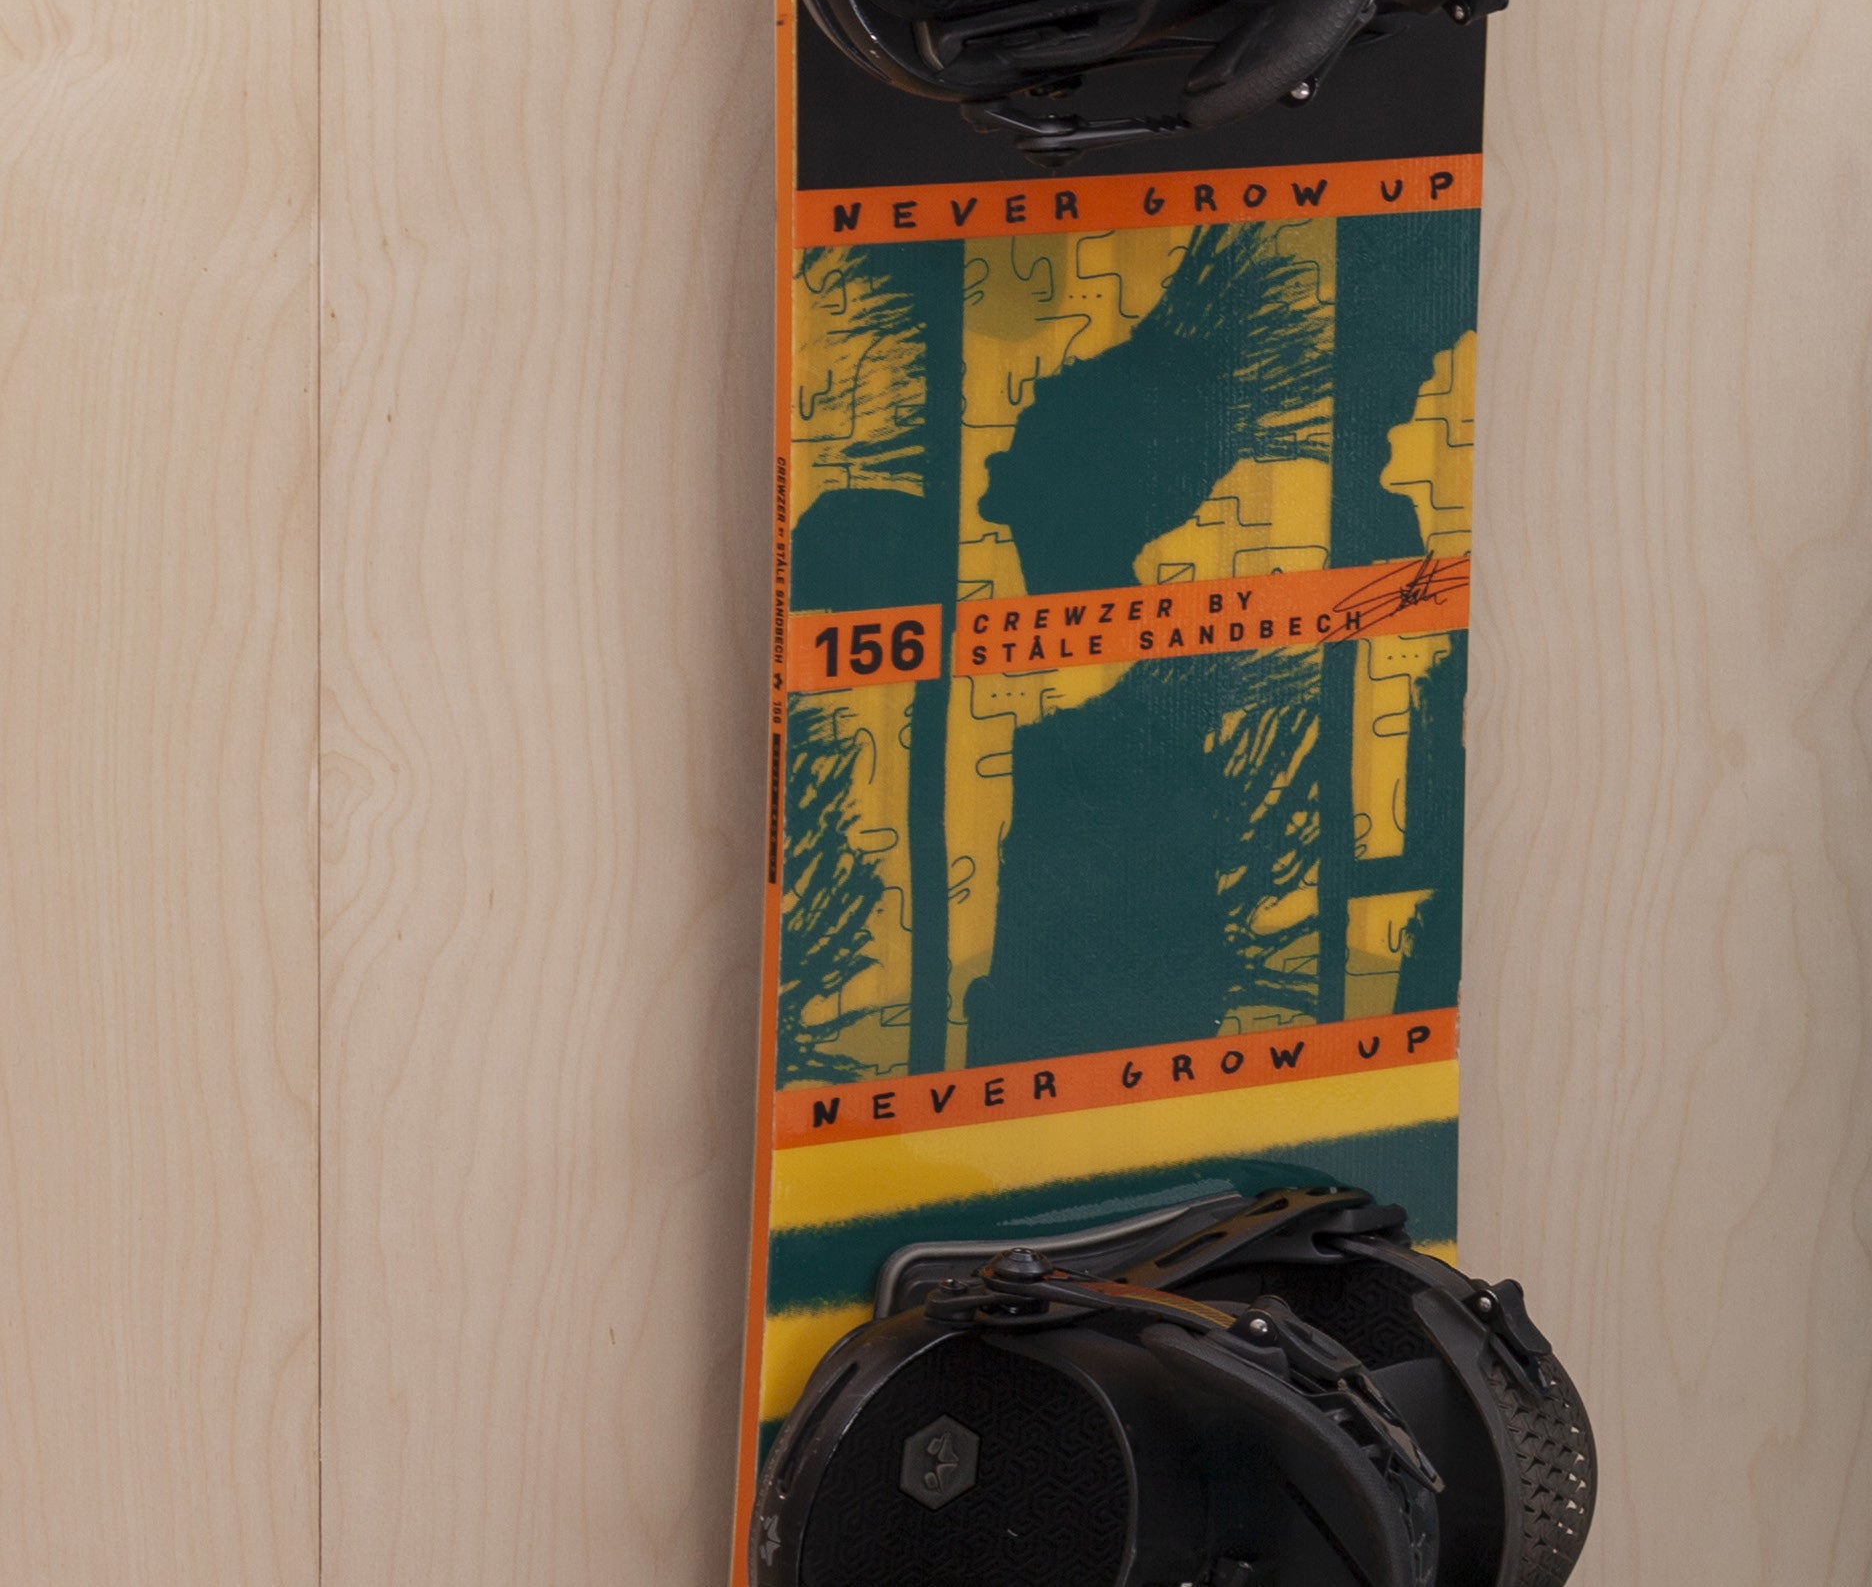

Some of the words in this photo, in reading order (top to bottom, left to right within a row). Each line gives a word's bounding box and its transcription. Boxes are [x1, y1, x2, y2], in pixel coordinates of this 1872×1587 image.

[831, 190, 1080, 232] NEVER
[1143, 179, 1328, 216] GROW
[1380, 171, 1455, 201] UP
[972, 635, 1103, 665] STÅLE
[1139, 611, 1361, 650] SANDBECH
[973, 598, 1173, 634] CREWZER
[1209, 590, 1253, 613] BY
[814, 619, 926, 678] 156
[812, 1072, 1057, 1127] NEVER
[1122, 1041, 1306, 1090] GROW
[1357, 1025, 1432, 1060] UP
